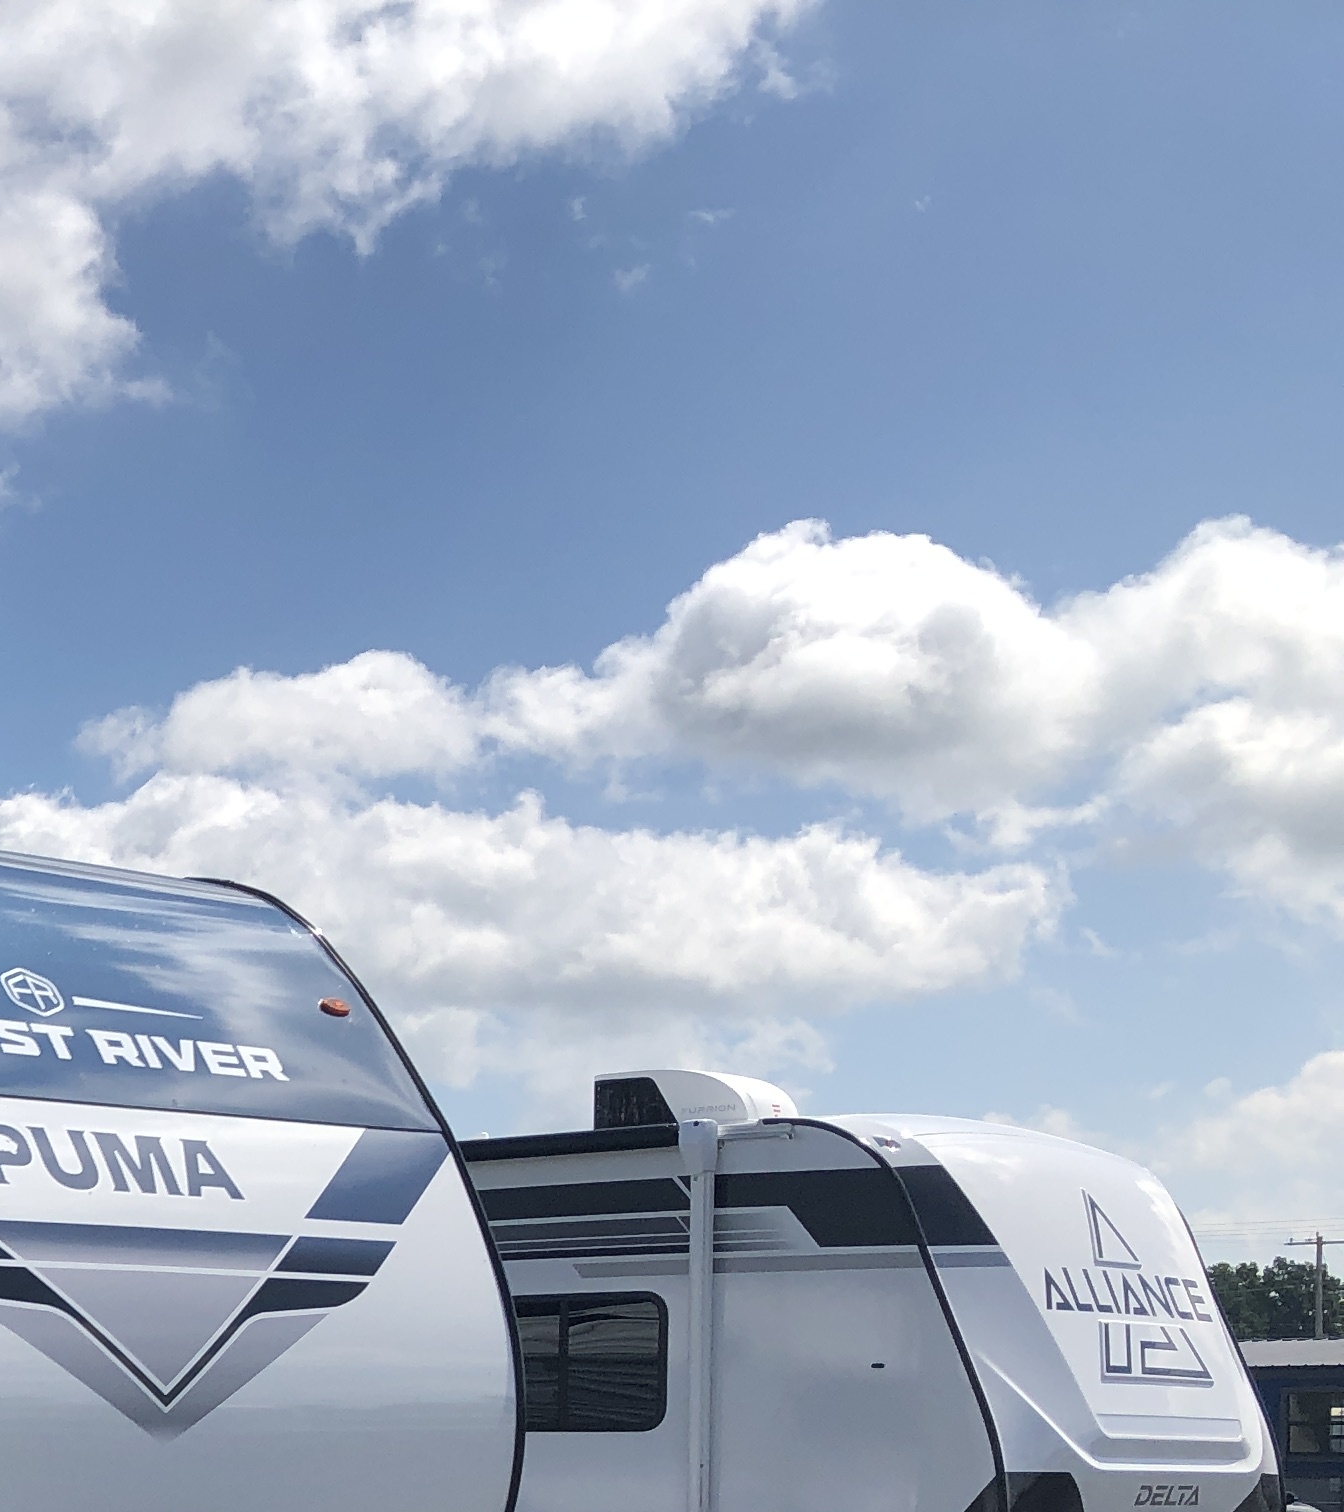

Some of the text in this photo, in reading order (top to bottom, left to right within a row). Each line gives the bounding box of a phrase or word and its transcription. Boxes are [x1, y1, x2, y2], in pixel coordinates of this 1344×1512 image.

[85, 1028, 290, 1082] RIVER
[1043, 1266, 1214, 1323] ALLIANCE
[1134, 1484, 1199, 1506] DELTA
